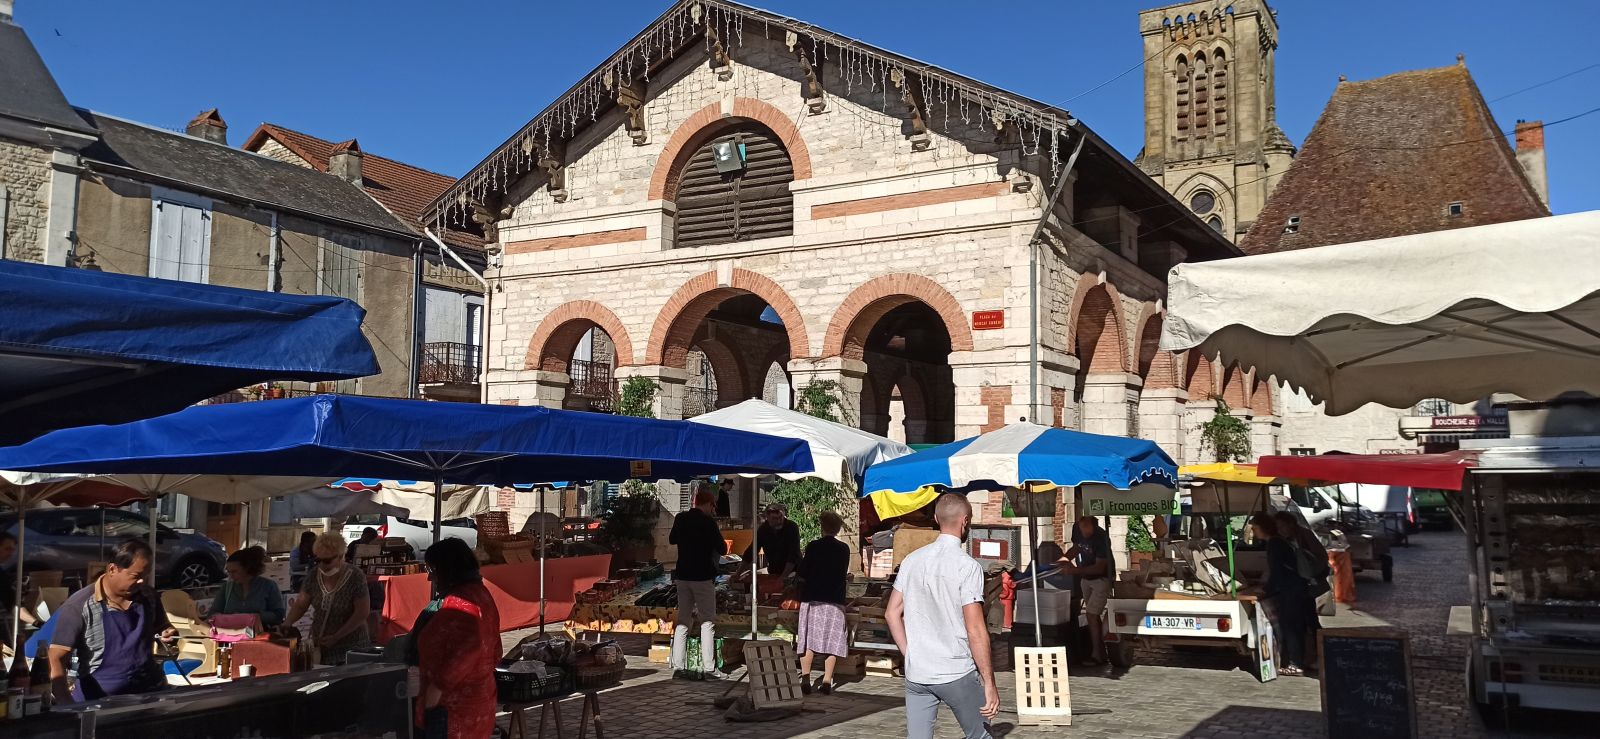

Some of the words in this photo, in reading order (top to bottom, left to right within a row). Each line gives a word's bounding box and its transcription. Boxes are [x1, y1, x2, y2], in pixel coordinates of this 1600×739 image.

[1434, 418, 1467, 426] BOUCHERIE
[1109, 501, 1157, 512] Fromages
[1161, 499, 1178, 510] BIO
